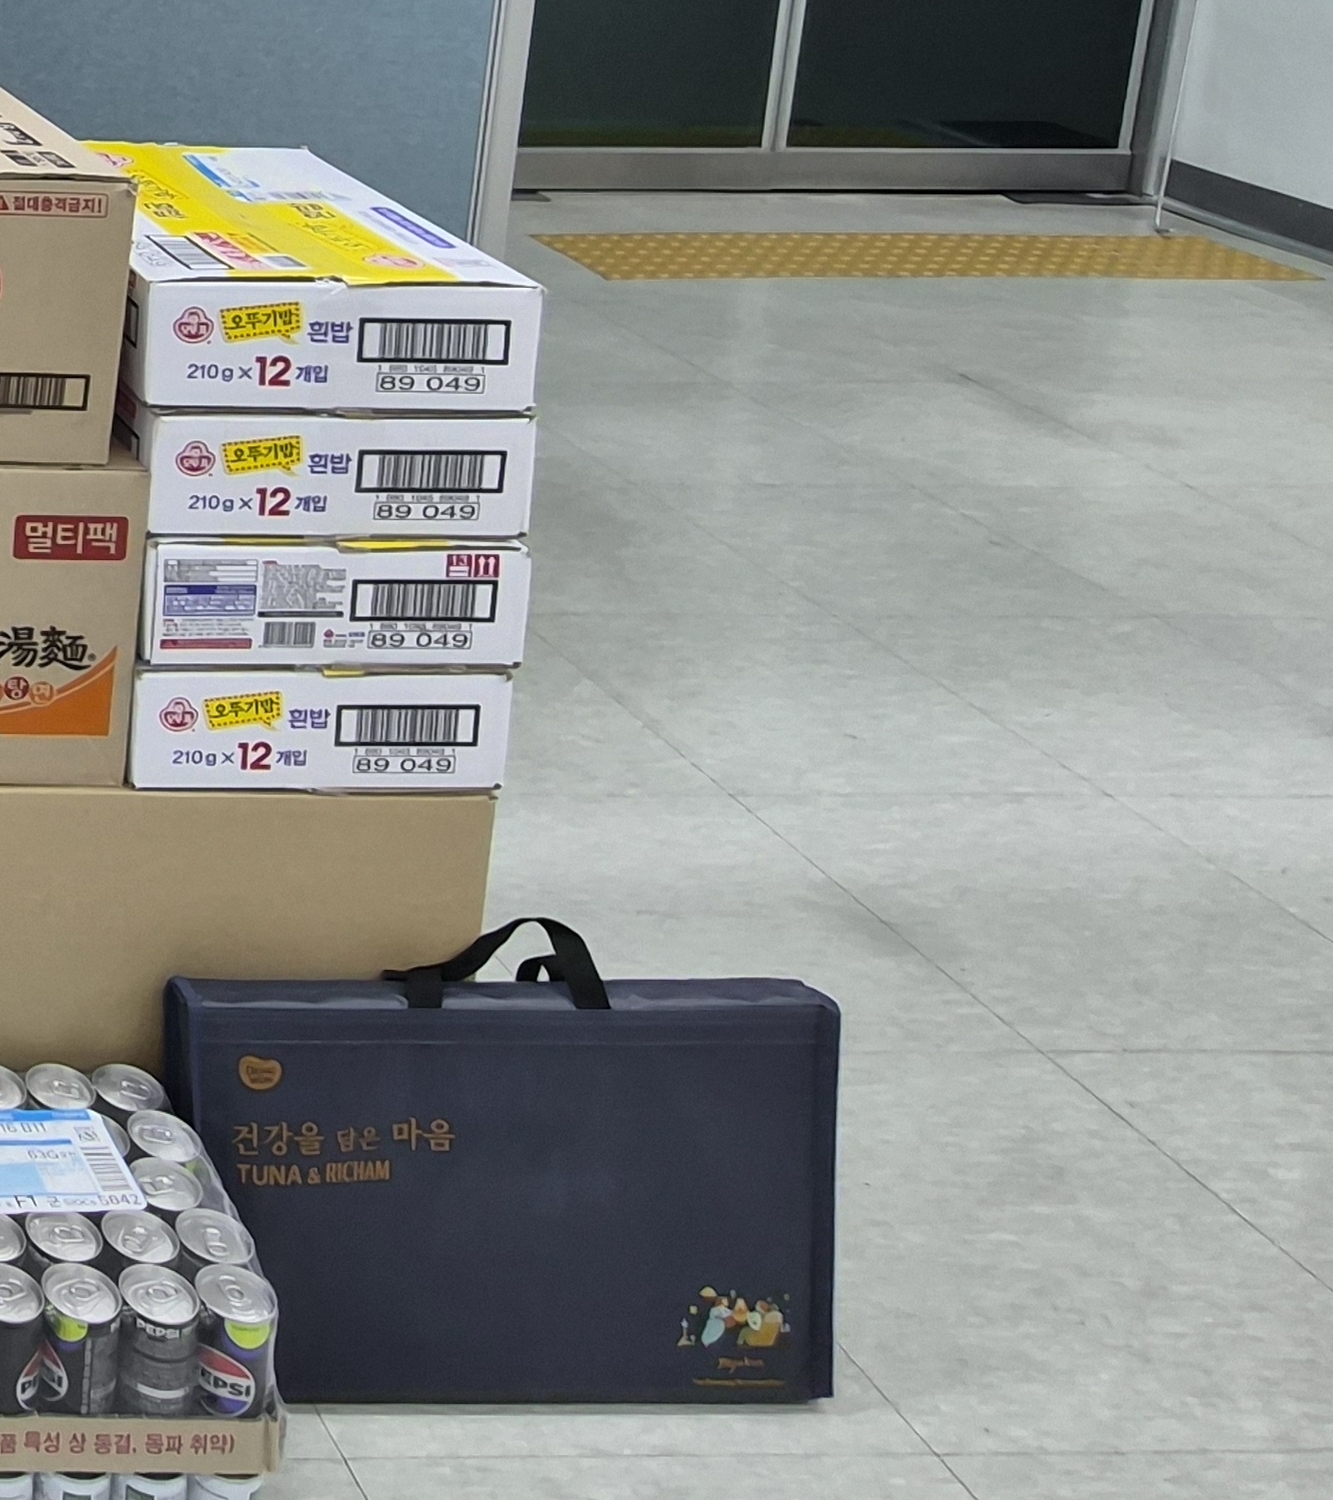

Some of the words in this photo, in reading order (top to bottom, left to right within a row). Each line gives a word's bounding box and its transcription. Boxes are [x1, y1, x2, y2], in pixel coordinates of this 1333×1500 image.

[379, 376, 415, 391] 89
[425, 376, 481, 392] 049
[377, 504, 413, 519] 89
[422, 504, 476, 519] 049
[24, 521, 118, 556] 멀티팩
[370, 633, 406, 648] 89
[415, 632, 470, 648] 049
[355, 758, 391, 773] 89
[399, 758, 453, 773] 049
[232, 1120, 326, 1157] 건강을
[336, 1126, 381, 1153] 담은
[391, 1116, 456, 1152] 마음
[236, 1162, 303, 1187] TUNA
[307, 1167, 322, 1185] &
[325, 1159, 391, 1183] RICHAM
[136, 1318, 181, 1340] PEPSI
[68, 1432, 87, 1454] 상
[189, 1432, 236, 1456] 취약)
